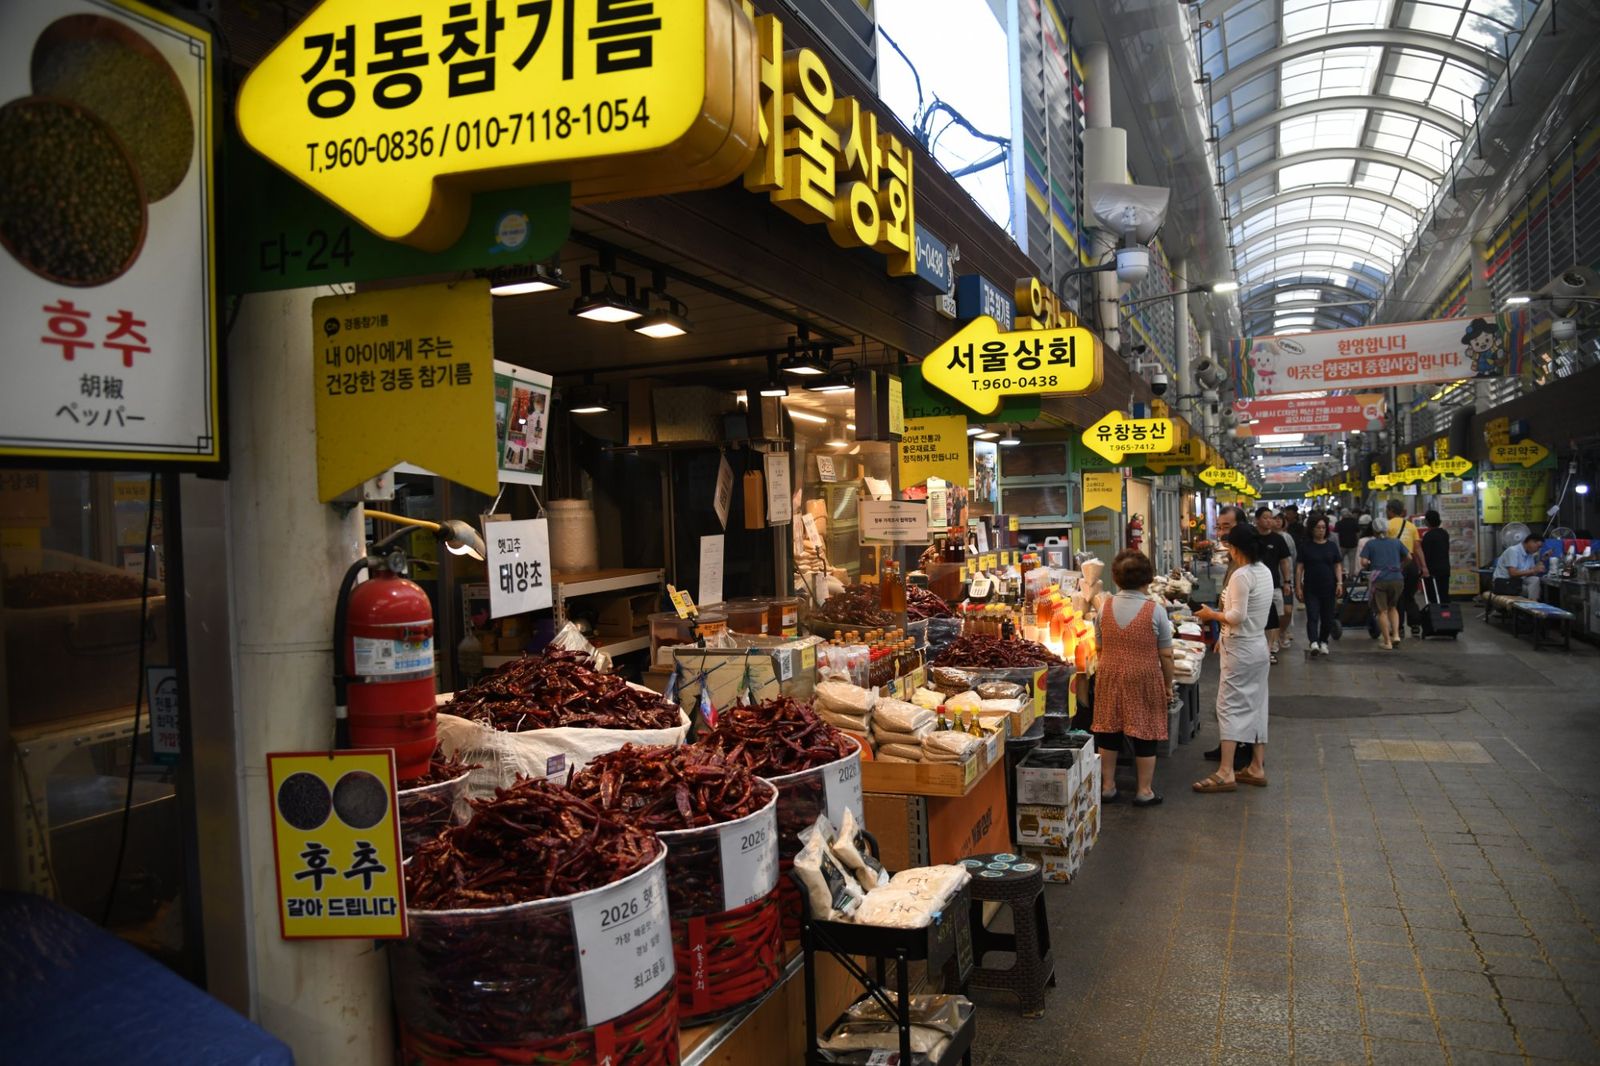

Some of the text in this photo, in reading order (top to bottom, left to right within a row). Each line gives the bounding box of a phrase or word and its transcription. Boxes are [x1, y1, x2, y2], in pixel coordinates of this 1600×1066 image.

[301, 0, 662, 119] 경동참기름
[307, 126, 434, 172] T.960-0836
[455, 95, 651, 152] 010-7118-1054
[259, 226, 355, 276] 다-24
[40, 299, 152, 368] 후추
[344, 314, 389, 331] 경동참기름
[325, 336, 454, 368] 내 아이에게 주는
[946, 335, 1077, 374] 서울상회
[1337, 335, 1407, 356] 환영합니다
[79, 373, 125, 400] 胡椒
[325, 362, 473, 396] 건강한 경동 참기름
[971, 375, 1058, 391] T.960-0438
[1287, 364, 1323, 380] 이곳은
[55, 401, 146, 428] ペッパー
[1096, 422, 1166, 442] 유창농산
[497, 538, 521, 555] 햇고추
[499, 560, 543, 594] 태양초
[740, 827, 766, 851] 2026
[294, 841, 387, 892] 후추
[287, 897, 397, 917] 갈아 드립니다
[600, 897, 639, 928] 2026
[614, 932, 631, 946] 가장
[633, 957, 666, 989] 최고품질
